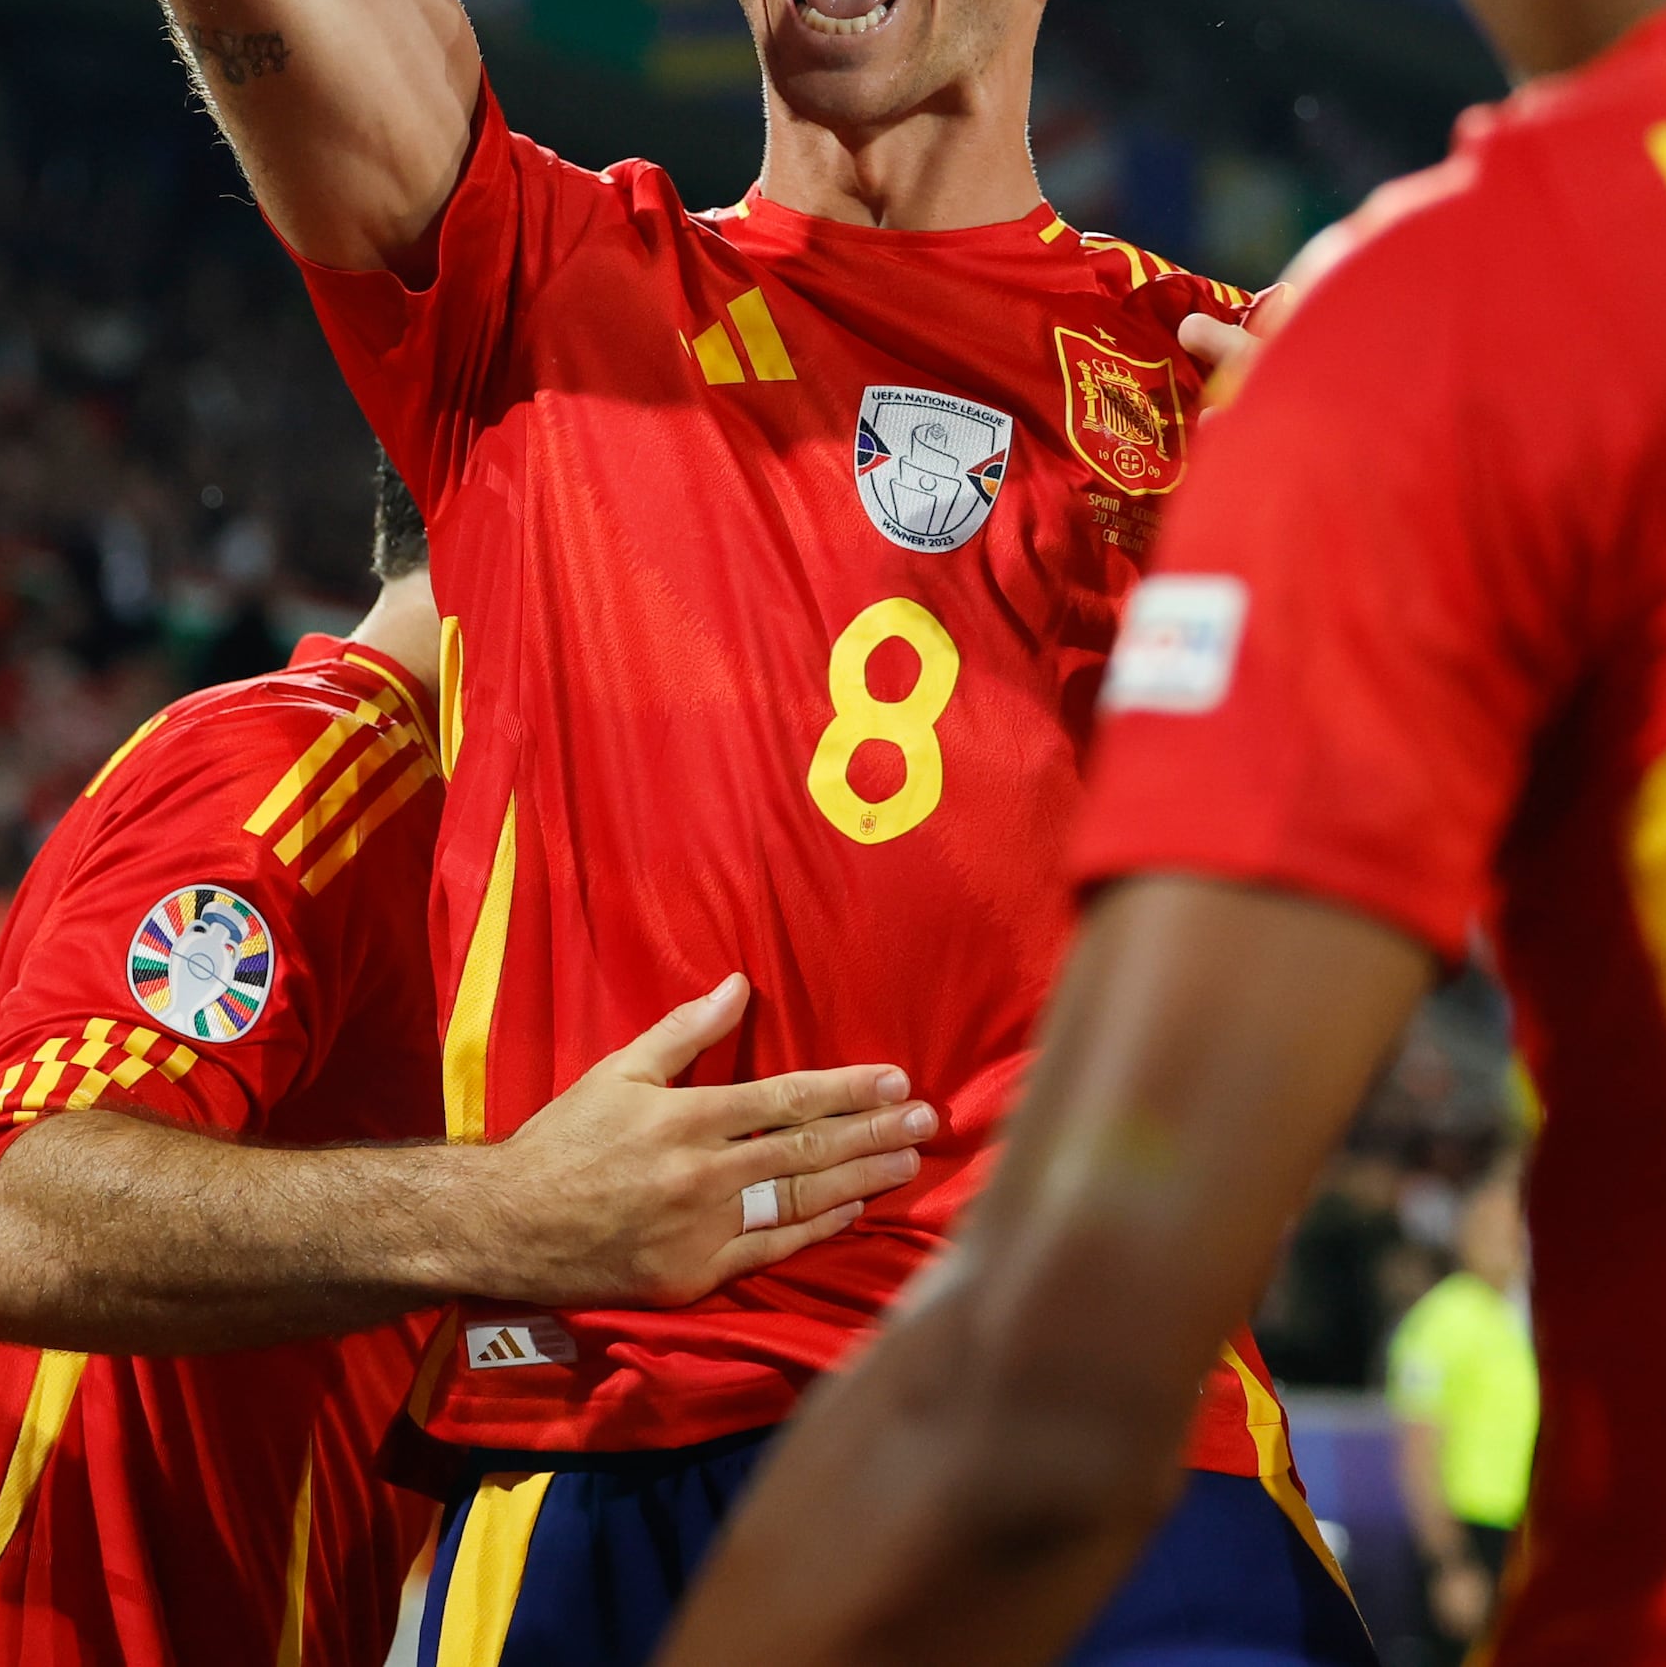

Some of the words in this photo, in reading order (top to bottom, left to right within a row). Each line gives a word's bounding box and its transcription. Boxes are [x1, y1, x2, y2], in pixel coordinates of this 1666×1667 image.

[871, 391, 902, 401] UEFA
[904, 392, 958, 411] NATIONS
[960, 404, 1006, 428] LEAGUE
[1098, 449, 1109, 461] 19
[1148, 465, 1160, 478] 09
[1088, 493, 1120, 512] SPAIN
[1092, 509, 1108, 524] 30
[882, 519, 926, 547] WINNER
[927, 535, 955, 547] 2023
[807, 597, 960, 845] 8
